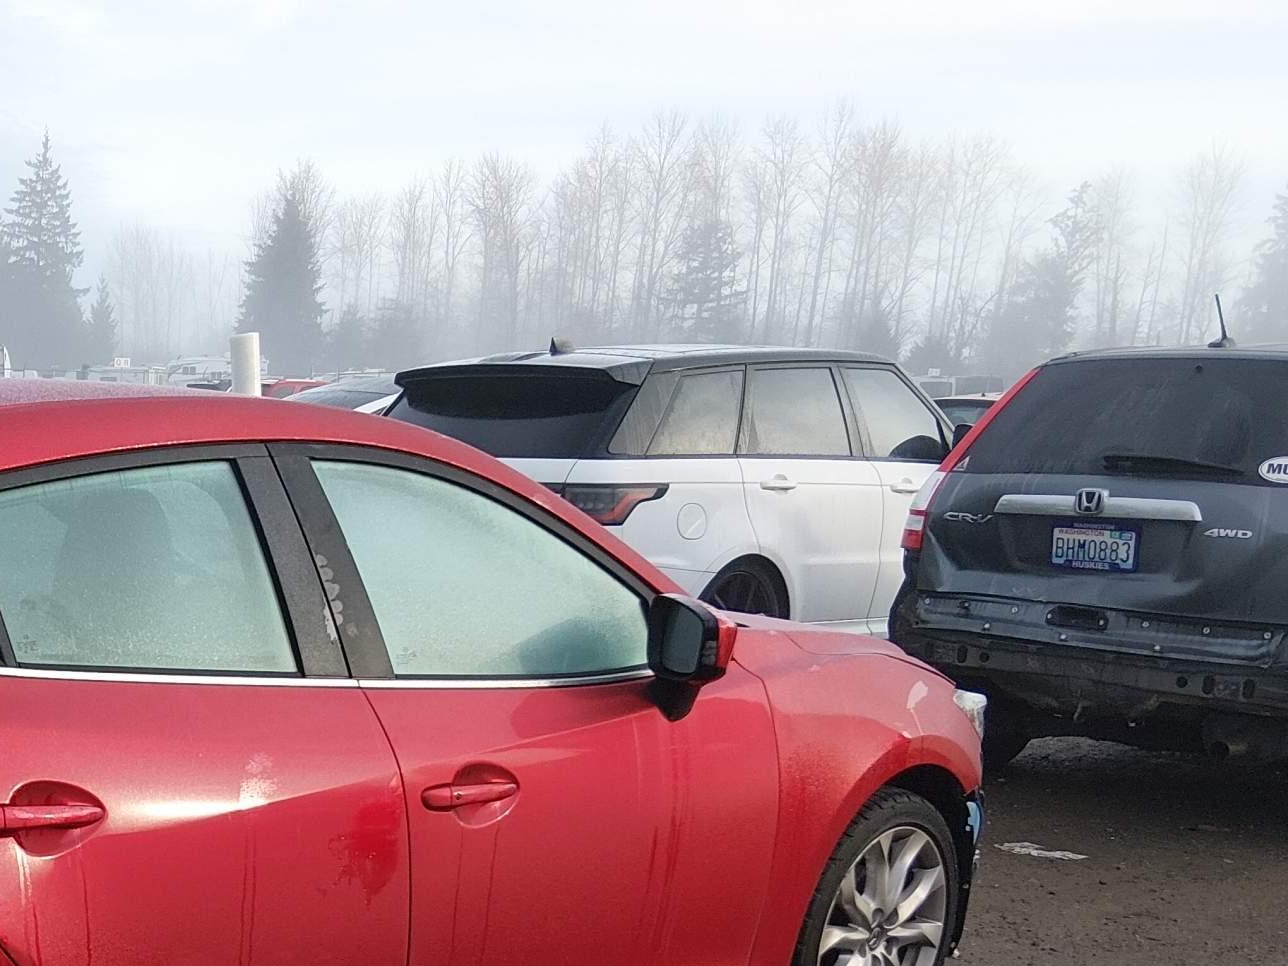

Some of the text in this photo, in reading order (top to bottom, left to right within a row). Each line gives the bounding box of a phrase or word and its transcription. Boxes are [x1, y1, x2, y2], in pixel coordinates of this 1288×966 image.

[1058, 528, 1105, 537] WASHINGTON
[1203, 528, 1253, 538] 4WD
[1055, 537, 1131, 563] BHM0883
[1072, 561, 1110, 570] HUSKIES
